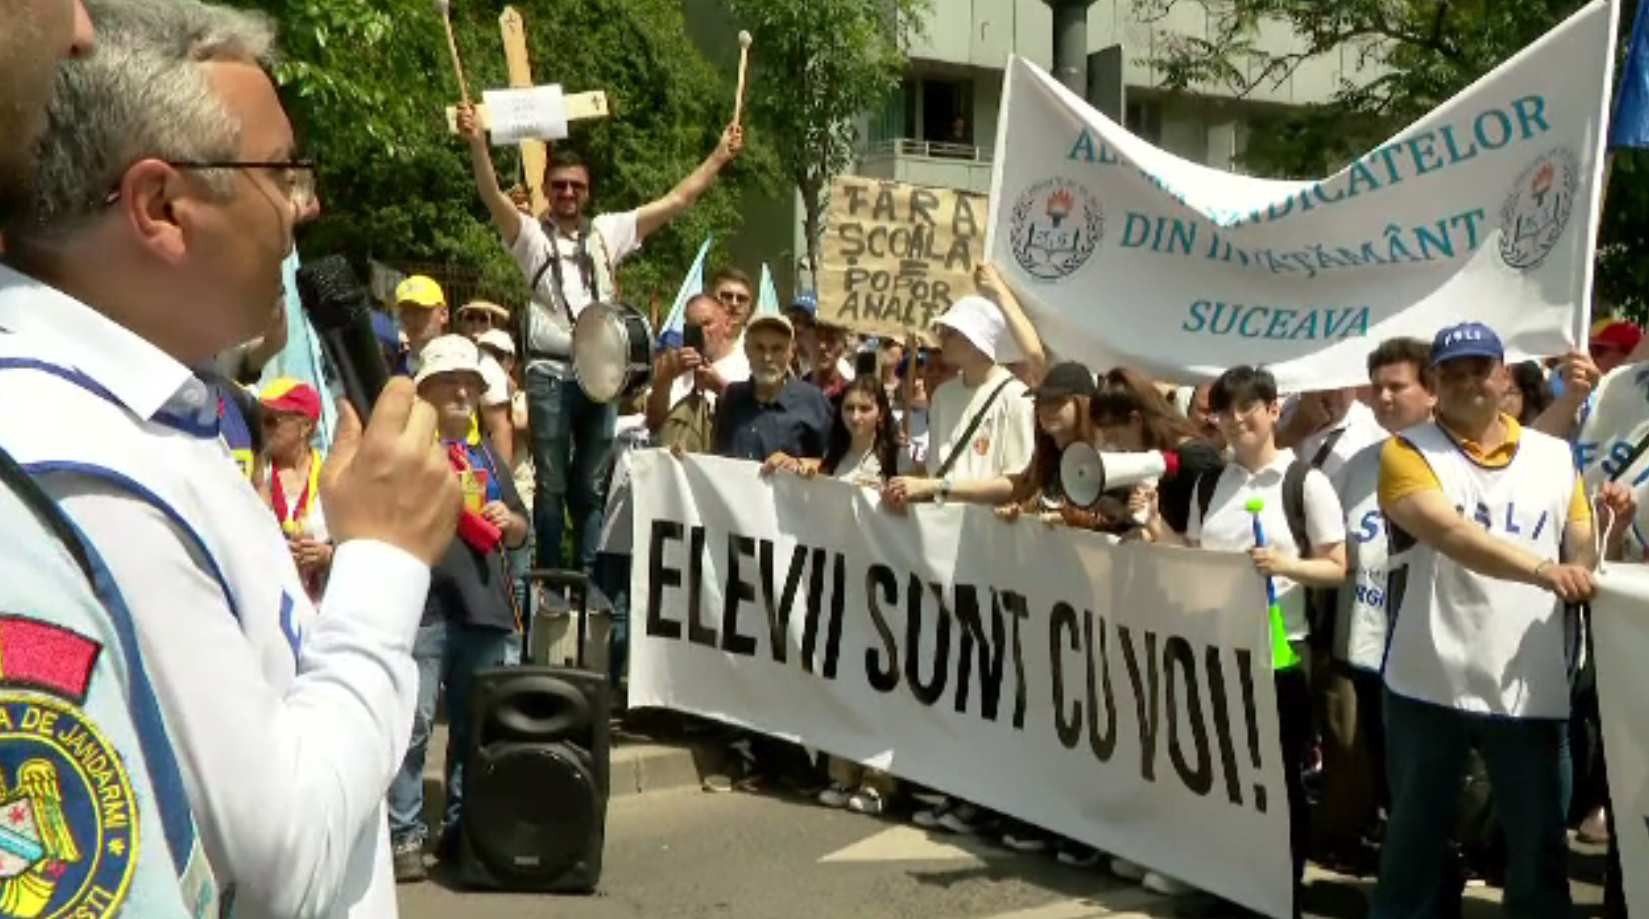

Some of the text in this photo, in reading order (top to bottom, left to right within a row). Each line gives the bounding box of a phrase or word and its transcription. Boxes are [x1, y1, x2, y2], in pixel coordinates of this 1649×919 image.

[1212, 95, 1550, 228] DICATELOR
[1119, 211, 1197, 256] DIN
[843, 267, 951, 302] POPOR
[1183, 300, 1371, 341] SUCEAVA
[646, 519, 1268, 815] ELEVII SUNT CU VOI!
[21, 706, 59, 737] DE
[58, 723, 128, 828] JANDARMI
